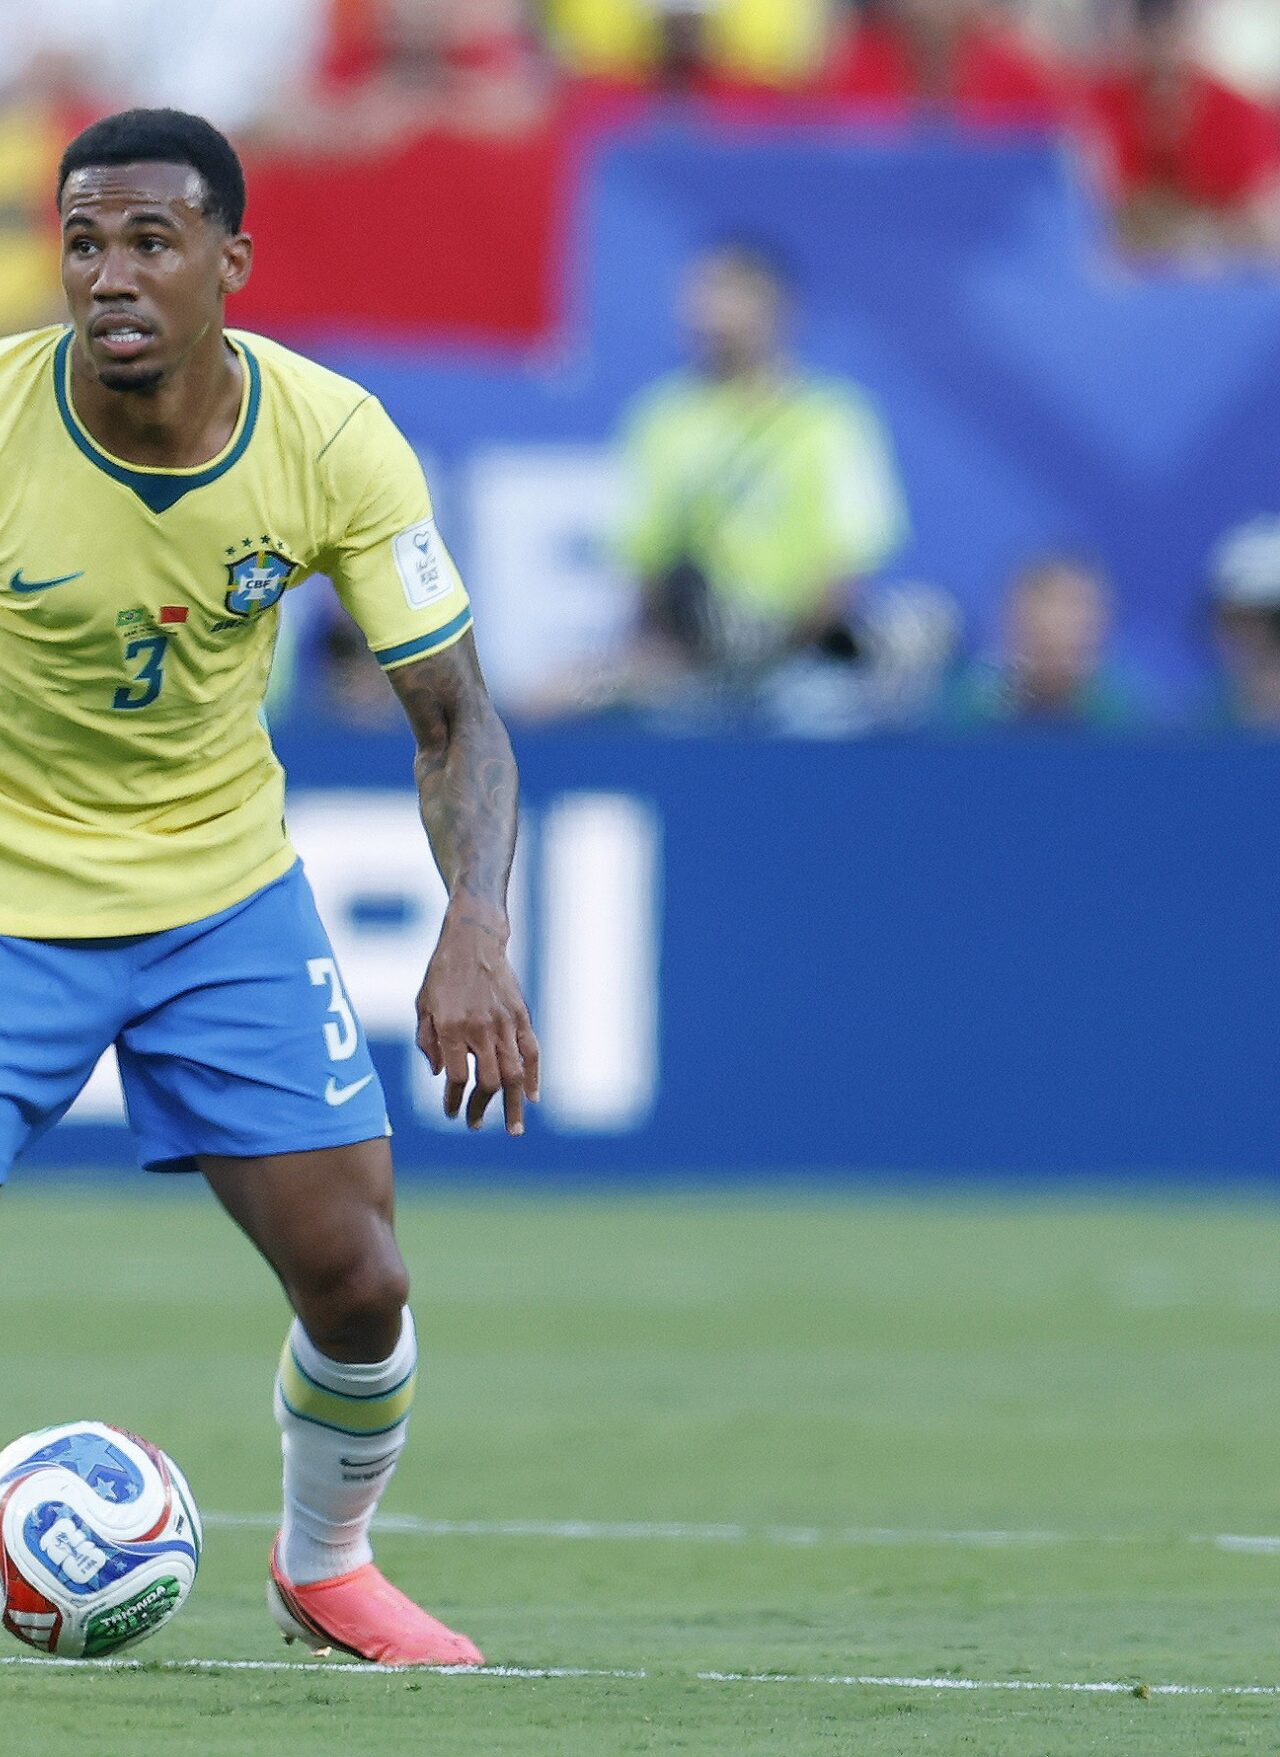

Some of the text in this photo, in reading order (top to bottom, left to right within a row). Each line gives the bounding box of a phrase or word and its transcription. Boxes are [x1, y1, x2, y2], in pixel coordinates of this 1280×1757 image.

[245, 579, 272, 589] CBF
[111, 636, 168, 709] 3
[306, 957, 358, 1062] 3
